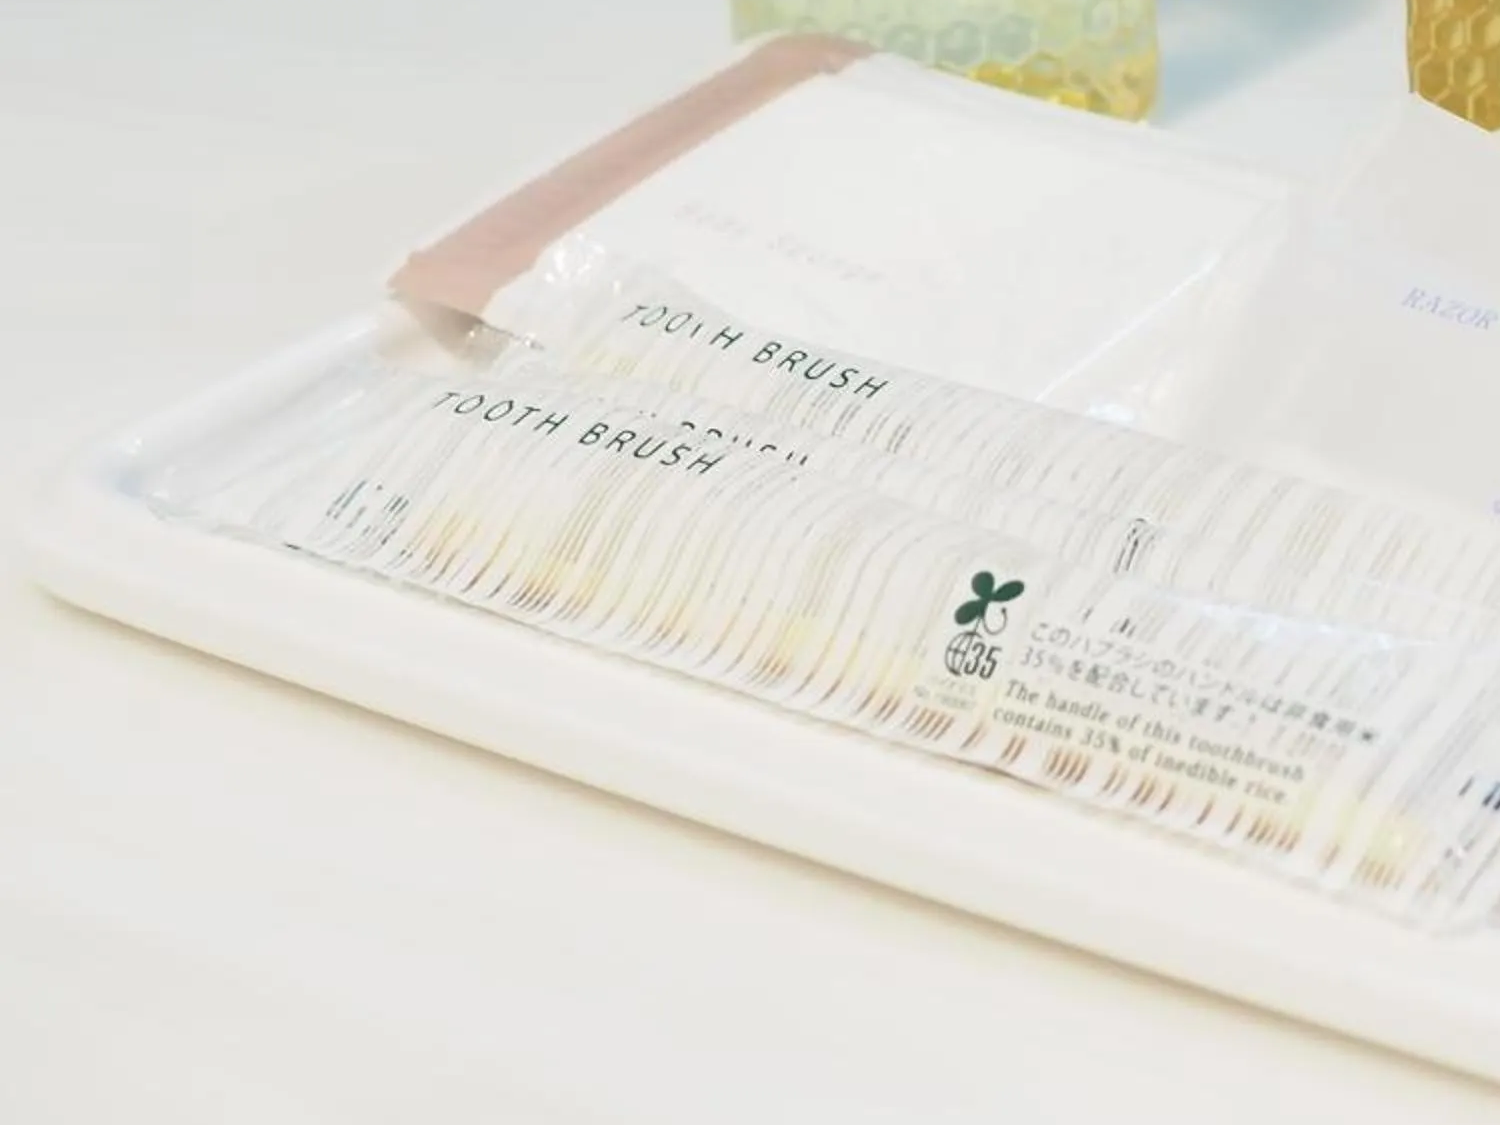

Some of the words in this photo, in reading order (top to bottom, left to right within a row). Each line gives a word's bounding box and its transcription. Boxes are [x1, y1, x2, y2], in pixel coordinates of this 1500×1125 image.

[1400, 285, 1500, 332] RAZOR
[750, 340, 890, 400] BRUSH
[431, 391, 571, 436] TOOTH
[576, 421, 726, 475] BRUSH
[963, 639, 1004, 681] 35
[1004, 678, 1038, 706] The
[1046, 691, 1111, 723] handle
[1116, 711, 1143, 731] of
[1142, 720, 1183, 747] this
[992, 706, 1073, 742] contains
[1078, 725, 1122, 756] 35%
[1128, 743, 1155, 764] of
[1154, 751, 1238, 790] inedible
